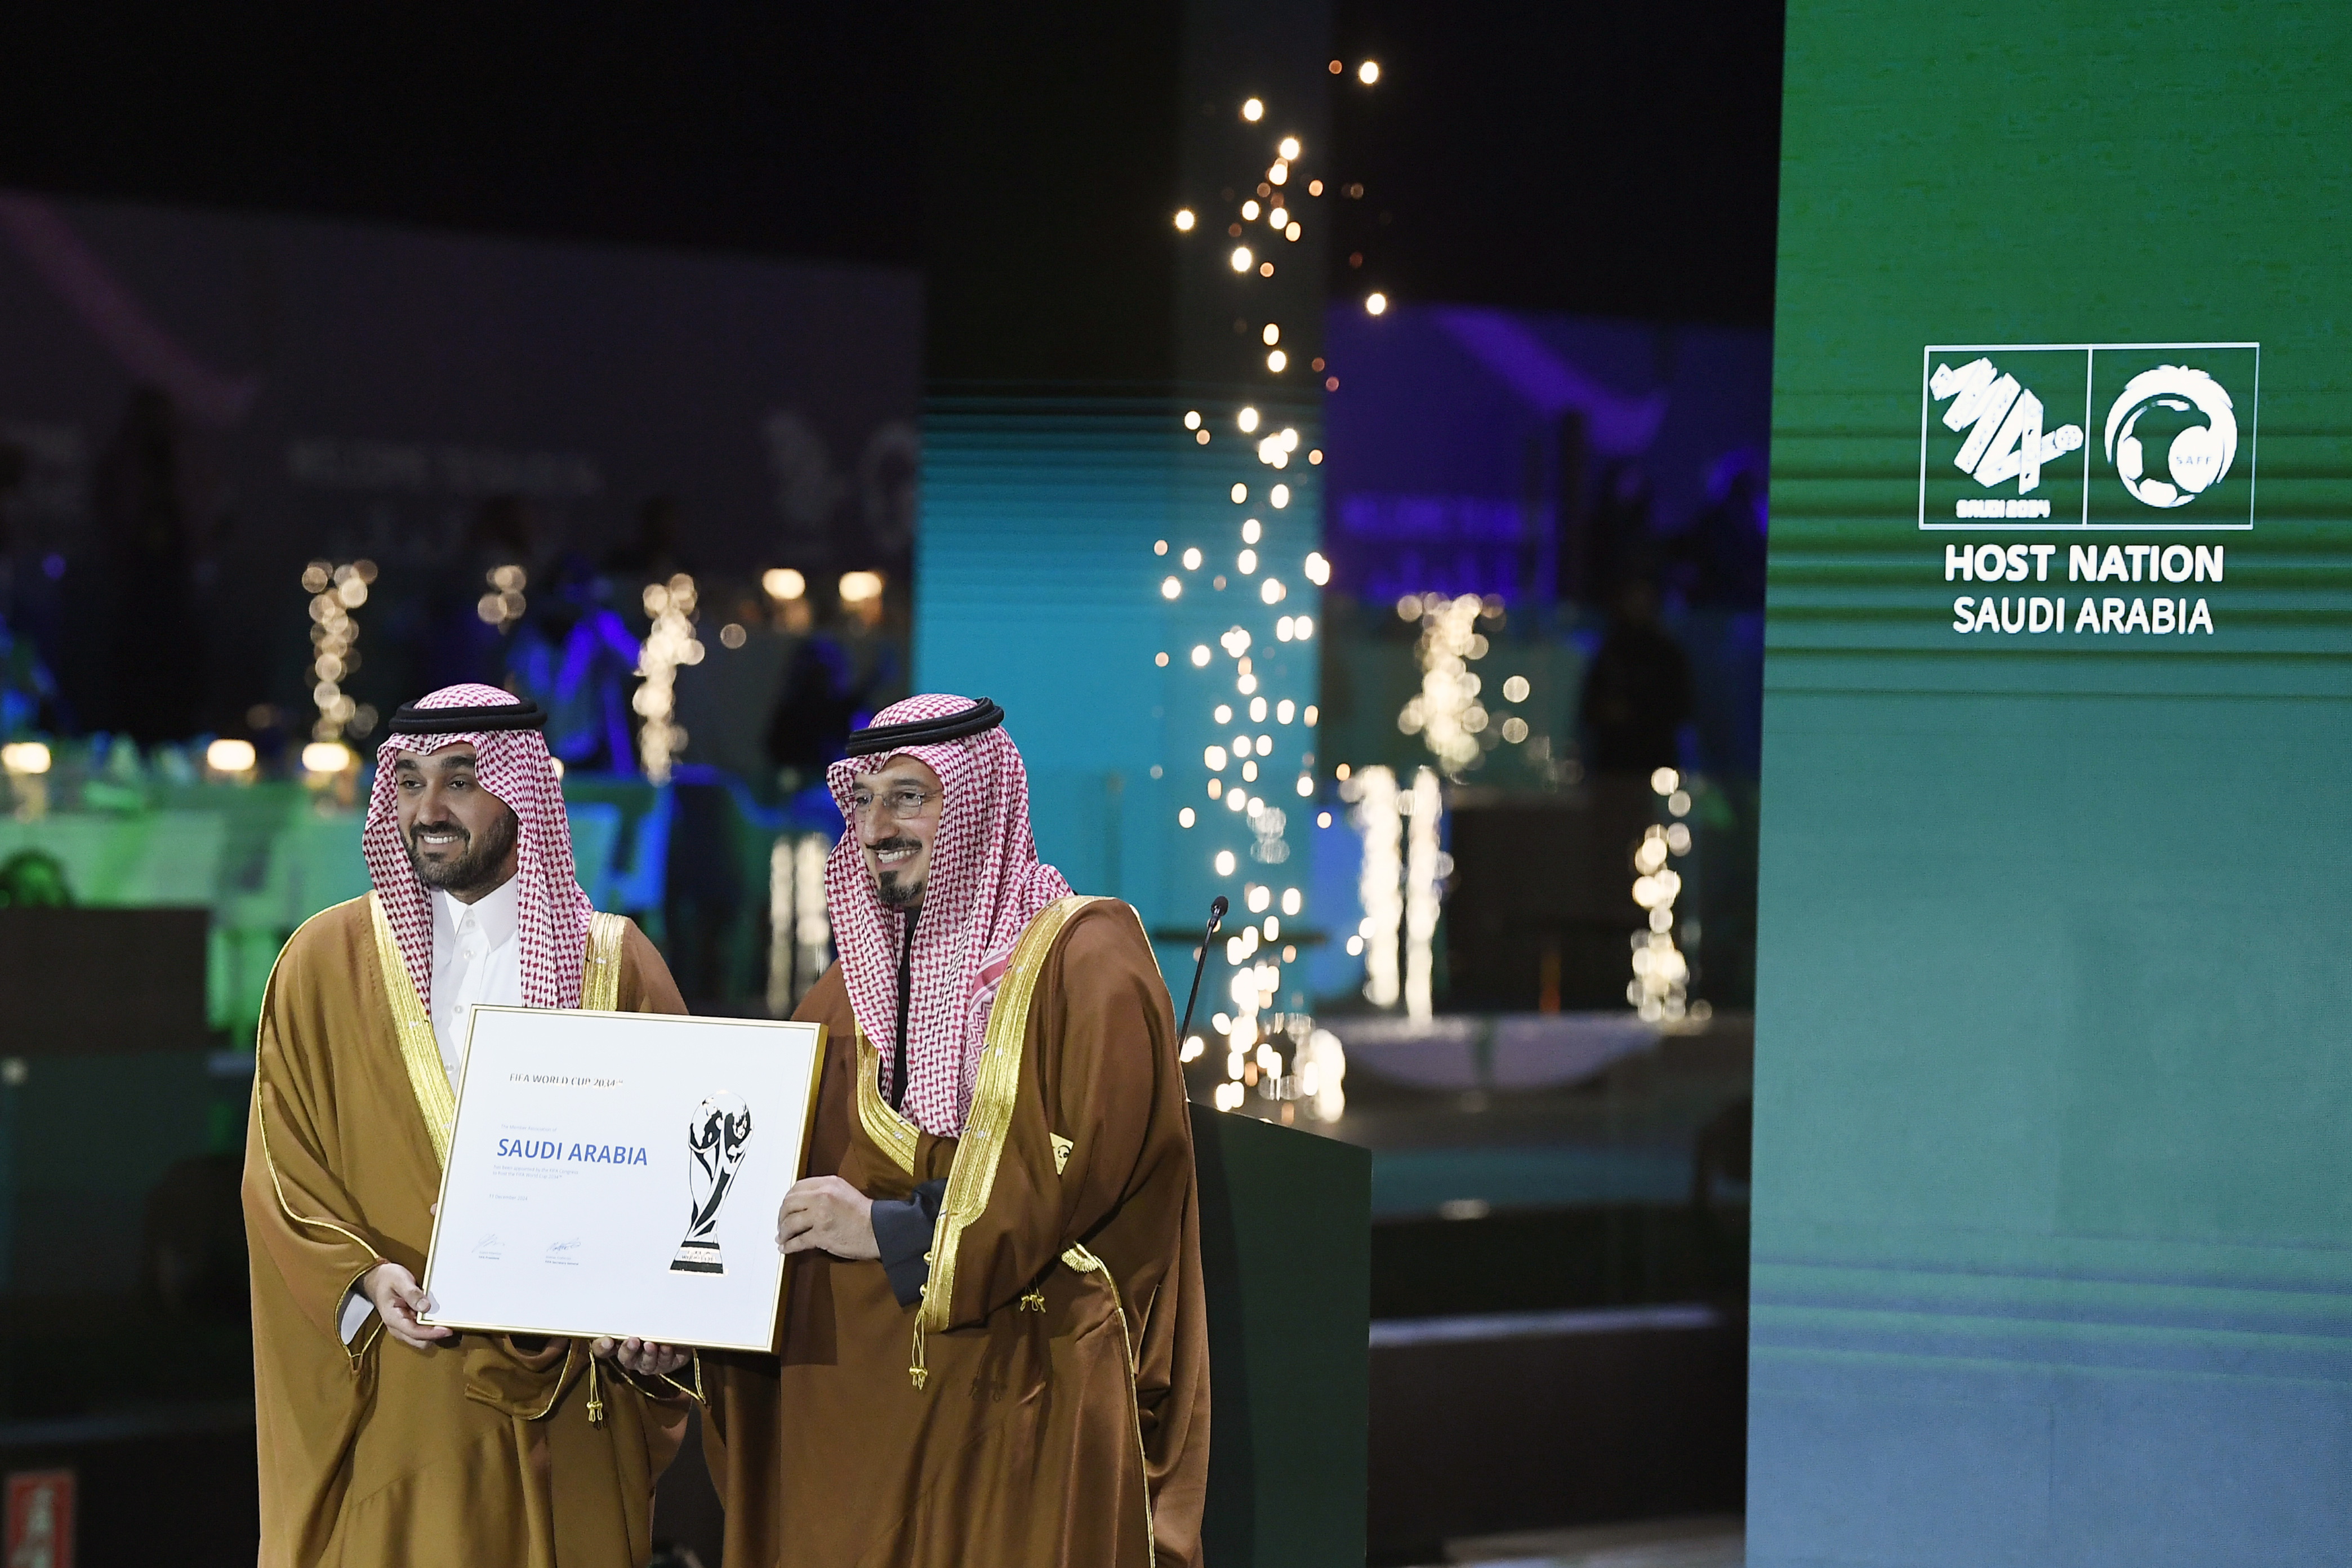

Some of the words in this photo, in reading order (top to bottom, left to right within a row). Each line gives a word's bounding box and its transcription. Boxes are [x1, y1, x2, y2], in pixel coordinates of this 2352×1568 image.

[2175, 455, 2212, 465] SAFF
[1945, 544, 2056, 582] HOST
[2069, 545, 2224, 582] NATION
[1953, 596, 2065, 634] SAUDI
[2074, 598, 2214, 635] ARABIA
[509, 1072, 529, 1083] FIFA
[532, 1074, 568, 1085] WORLD
[571, 1076, 591, 1086] CUP
[497, 1138, 562, 1160] SAUDI
[568, 1143, 647, 1166] ARABIA
